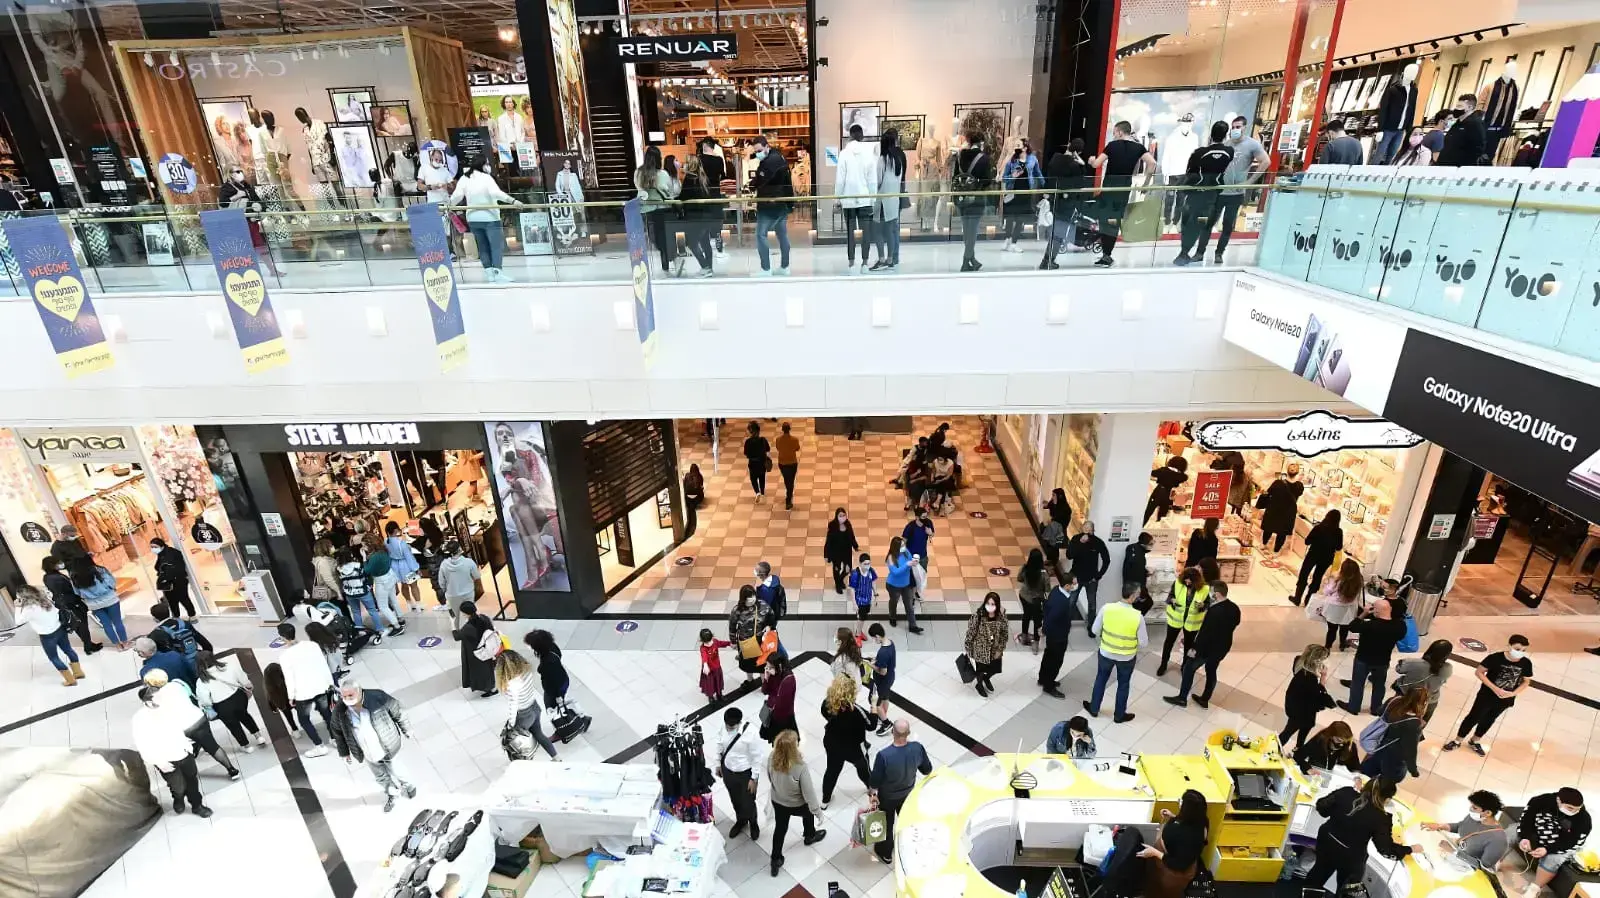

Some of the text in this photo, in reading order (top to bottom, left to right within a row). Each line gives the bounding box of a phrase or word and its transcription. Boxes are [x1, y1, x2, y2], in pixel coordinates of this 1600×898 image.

[618, 40, 730, 56] RENUAR
[1293, 230, 1318, 253] YOLO
[1332, 237, 1360, 262] YOLO
[28, 261, 72, 278] WELCOME
[220, 255, 255, 271] WELCOME
[1379, 245, 1412, 272] YOLO
[1435, 254, 1477, 284] YOLO
[1504, 266, 1556, 301] YOLO
[1250, 308, 1302, 339] Galaxy Note20
[1423, 376, 1578, 453] Galaxy Note20 Ultra
[284, 422, 420, 446] STEVE MADDEN
